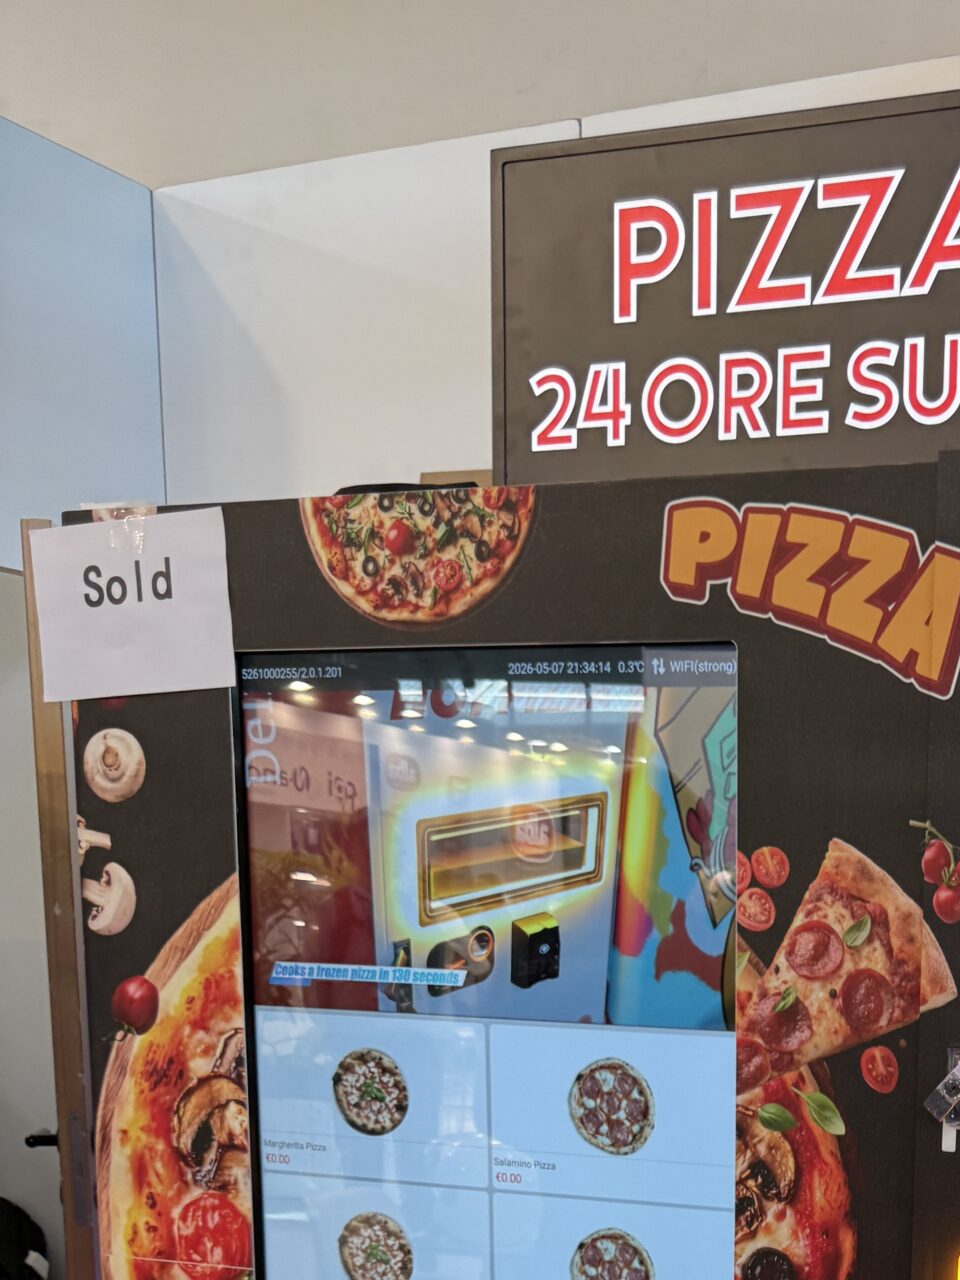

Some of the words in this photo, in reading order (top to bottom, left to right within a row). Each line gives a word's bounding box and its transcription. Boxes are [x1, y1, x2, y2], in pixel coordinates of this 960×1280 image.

[529, 361, 631, 453] 24
[641, 343, 831, 445] ORE
[83, 557, 173, 608] Sold
[508, 662, 564, 675] 2026-05-07
[567, 661, 611, 674] 21:34:14
[670, 658, 737, 675] WIFI(strong)
[275, 963, 306, 977] Cooks
[316, 965, 349, 979] frozen
[350, 968, 377, 981] pizza
[379, 967, 390, 981] in
[412, 970, 460, 985] seconds
[305, 1142, 327, 1152] Pizza
[493, 1157, 532, 1169] Salamino
[533, 1160, 557, 1171] Pizza
[495, 1172, 522, 1184] €0.00
